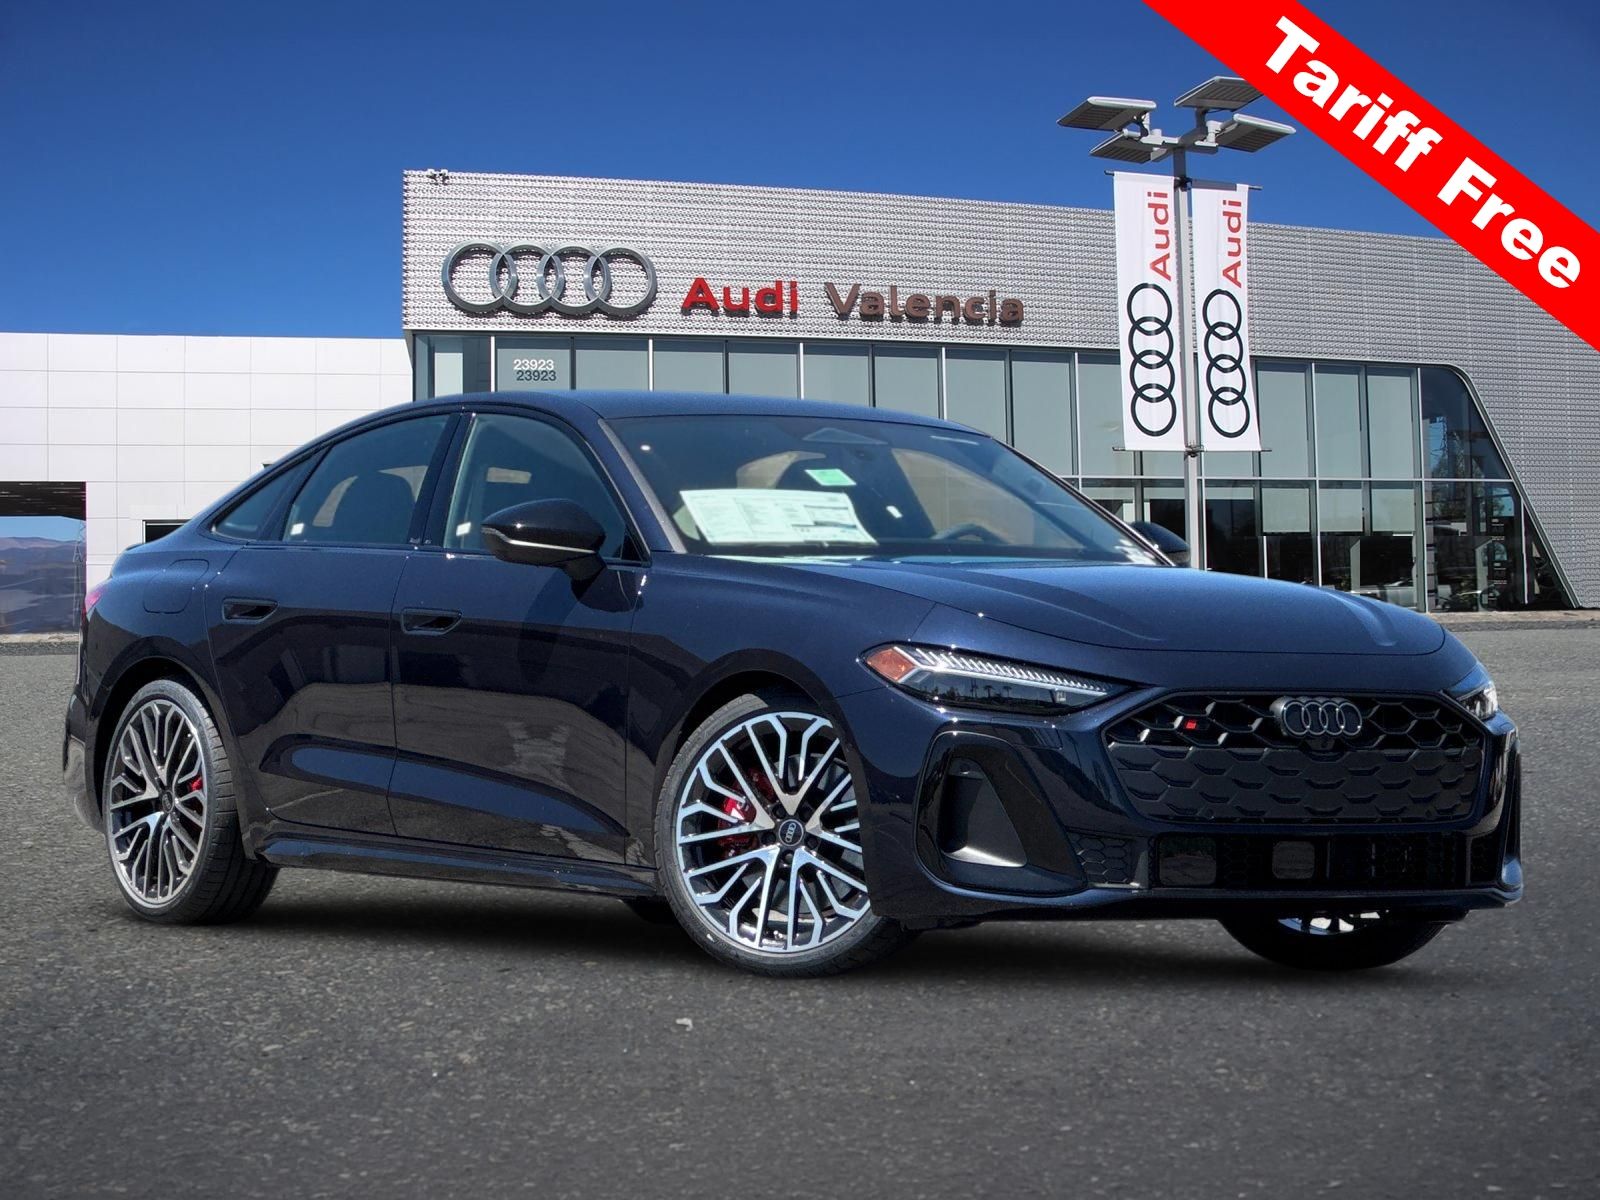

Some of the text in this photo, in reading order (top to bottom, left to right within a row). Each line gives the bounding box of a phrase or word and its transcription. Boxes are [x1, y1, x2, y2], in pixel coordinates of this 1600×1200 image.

[1147, 192, 1171, 281] Audi
[1222, 200, 1242, 288] Audi
[681, 277, 1024, 322] Audi Valencia
[513, 359, 554, 370] 23923
[516, 370, 557, 381] 23923
